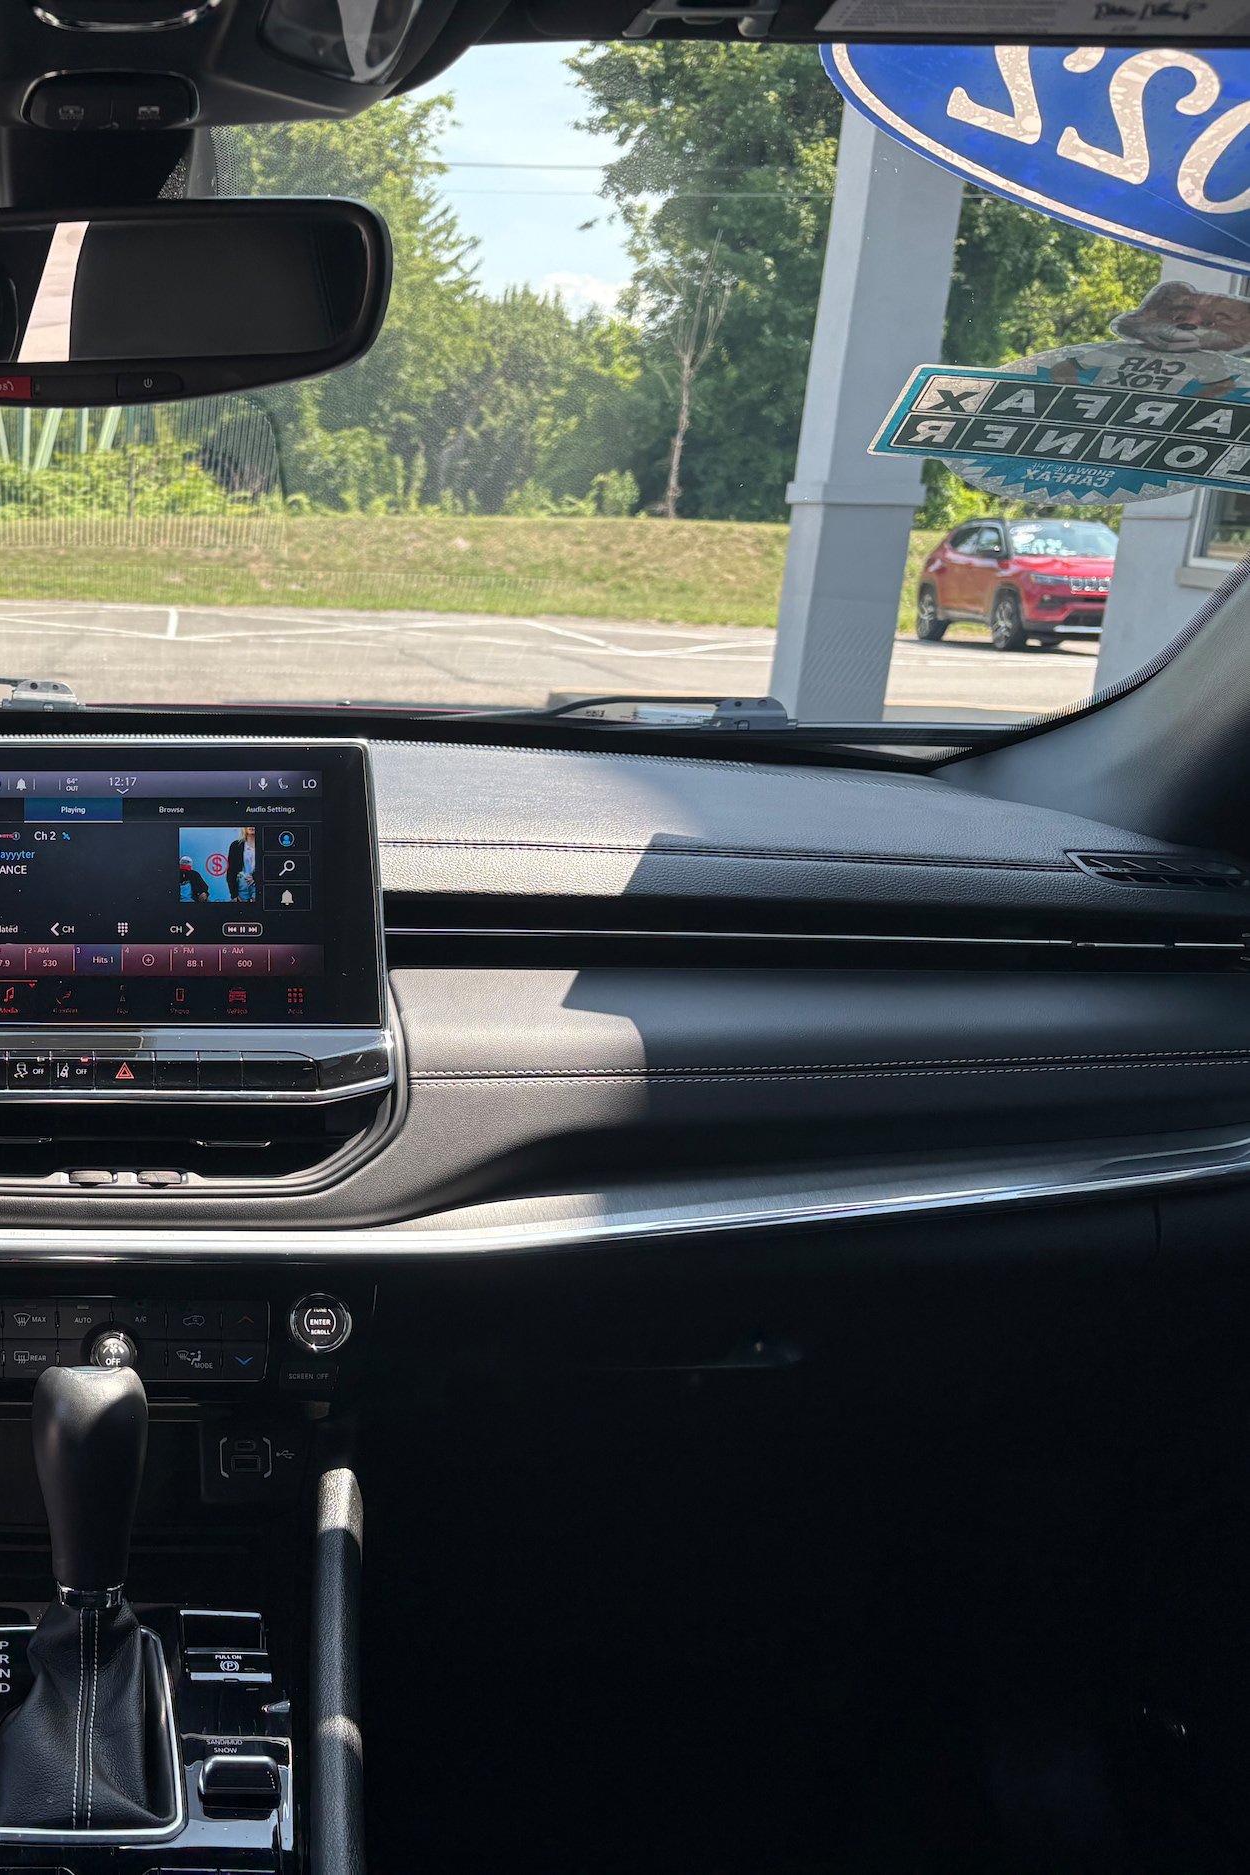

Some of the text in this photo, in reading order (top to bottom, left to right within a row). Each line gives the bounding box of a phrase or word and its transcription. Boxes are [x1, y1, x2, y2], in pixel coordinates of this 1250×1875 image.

[109, 777, 137, 787] 12:17
[302, 779, 317, 789] LO
[61, 806, 86, 815] Playing
[267, 806, 295, 815] Settings
[34, 831, 57, 840] Ch 2
[62, 925, 75, 933] CH
[170, 925, 183, 933] CH
[74, 1316, 92, 1324] AUTO
[309, 1318, 331, 1326] ENTER
[30, 1354, 47, 1362] REAR
[105, 1357, 121, 1366] OFF
[0, 1640, 9, 1650] P
[0, 1654, 10, 1664] R
[0, 1668, 11, 1679] N
[0, 1683, 11, 1693] D
